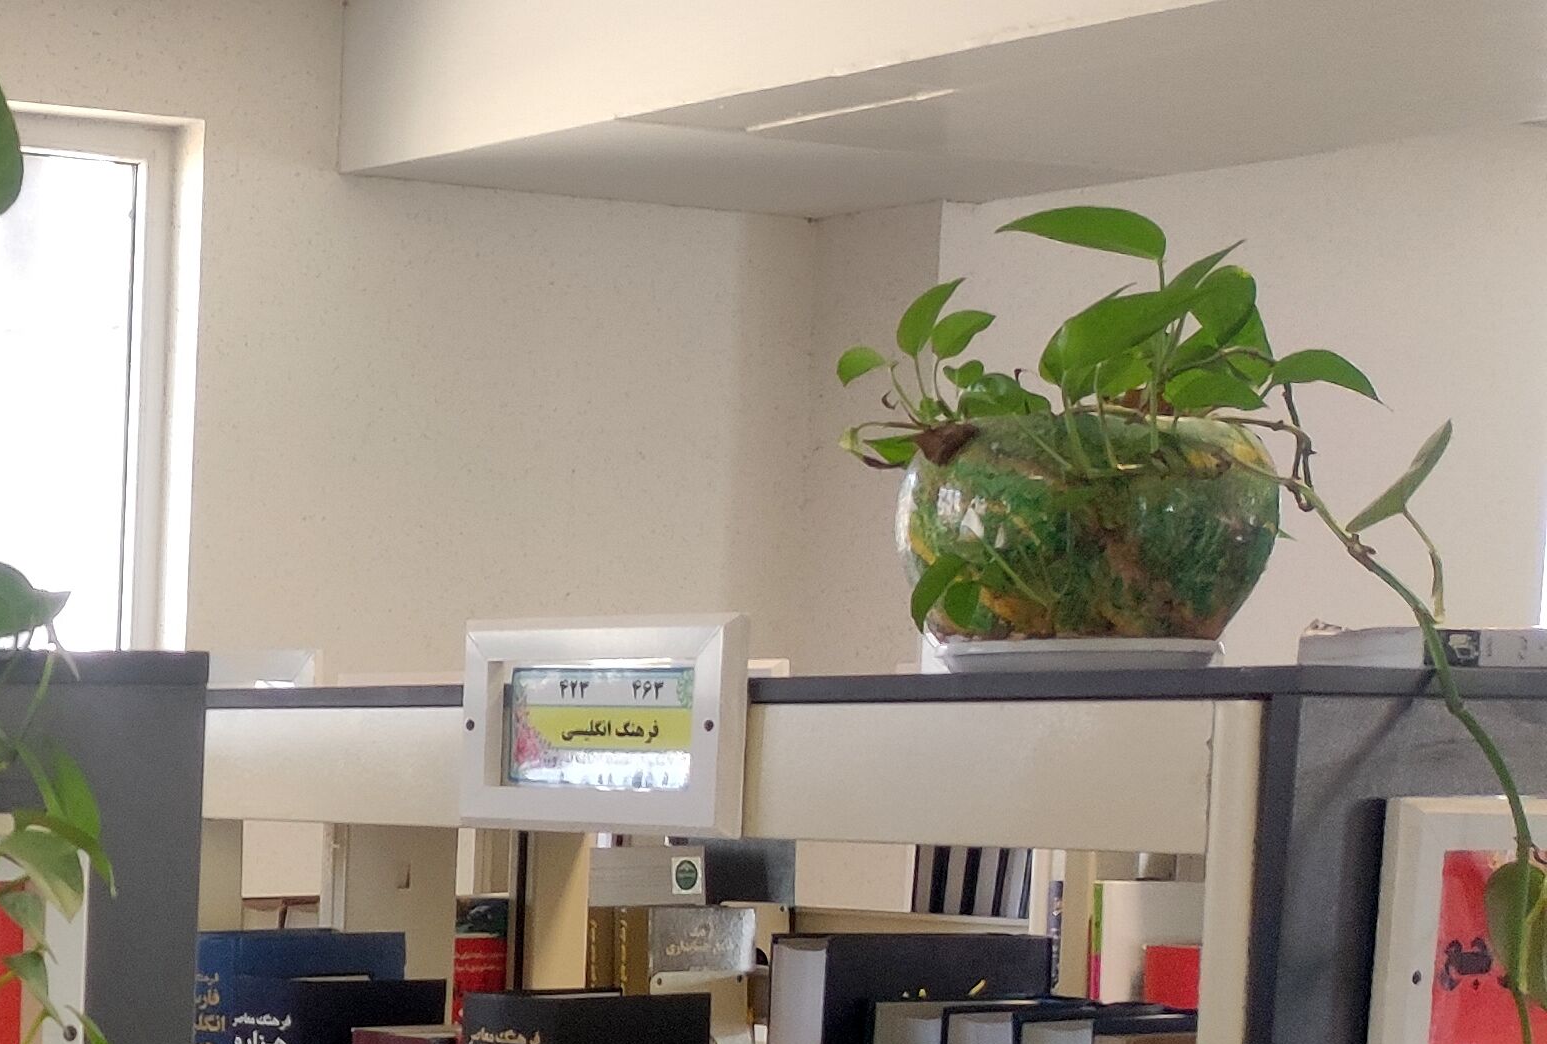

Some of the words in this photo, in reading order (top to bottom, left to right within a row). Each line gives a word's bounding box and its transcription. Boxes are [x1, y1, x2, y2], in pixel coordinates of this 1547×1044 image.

[559, 679, 590, 700] ۴۲۳
[632, 680, 664, 701] ۴۶۳
[560, 719, 612, 742] انگلیسی
[614, 720, 660, 743] فرهنگ
[256, 1013, 292, 1031] فرهنگ
